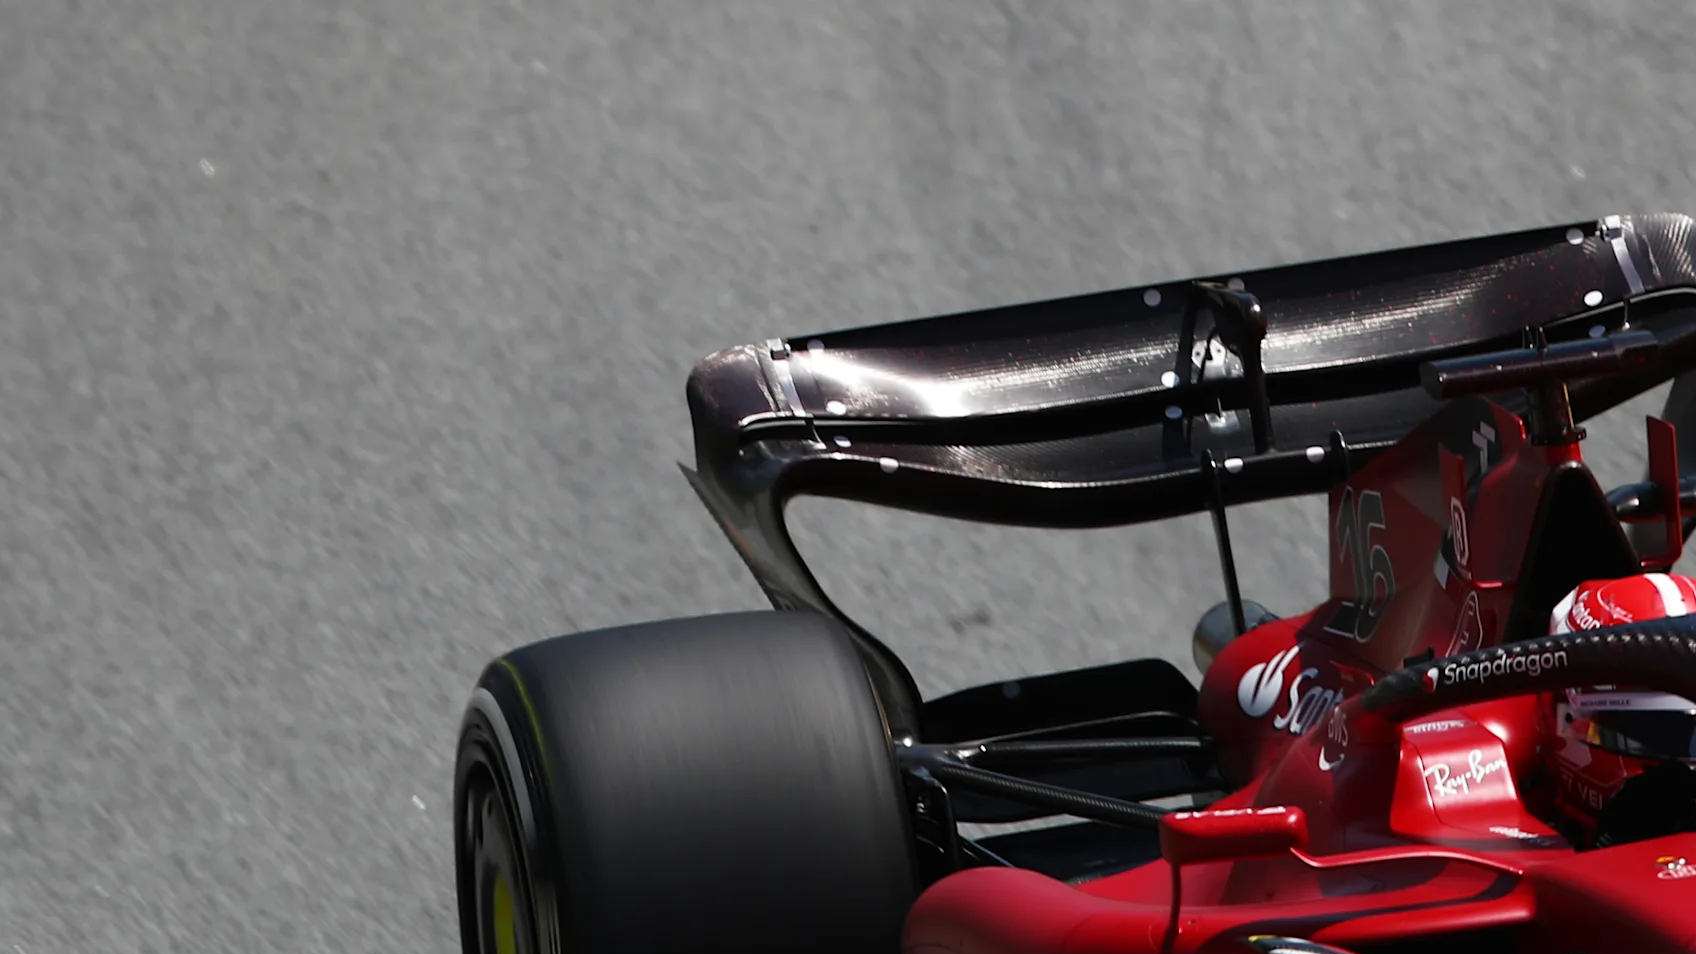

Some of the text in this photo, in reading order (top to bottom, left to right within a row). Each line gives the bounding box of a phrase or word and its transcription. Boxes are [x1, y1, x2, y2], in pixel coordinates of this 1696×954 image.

[1322, 485, 1396, 643] 16
[1443, 650, 1568, 685] Snapdragon
[1424, 749, 1507, 797] Ray-Ban
